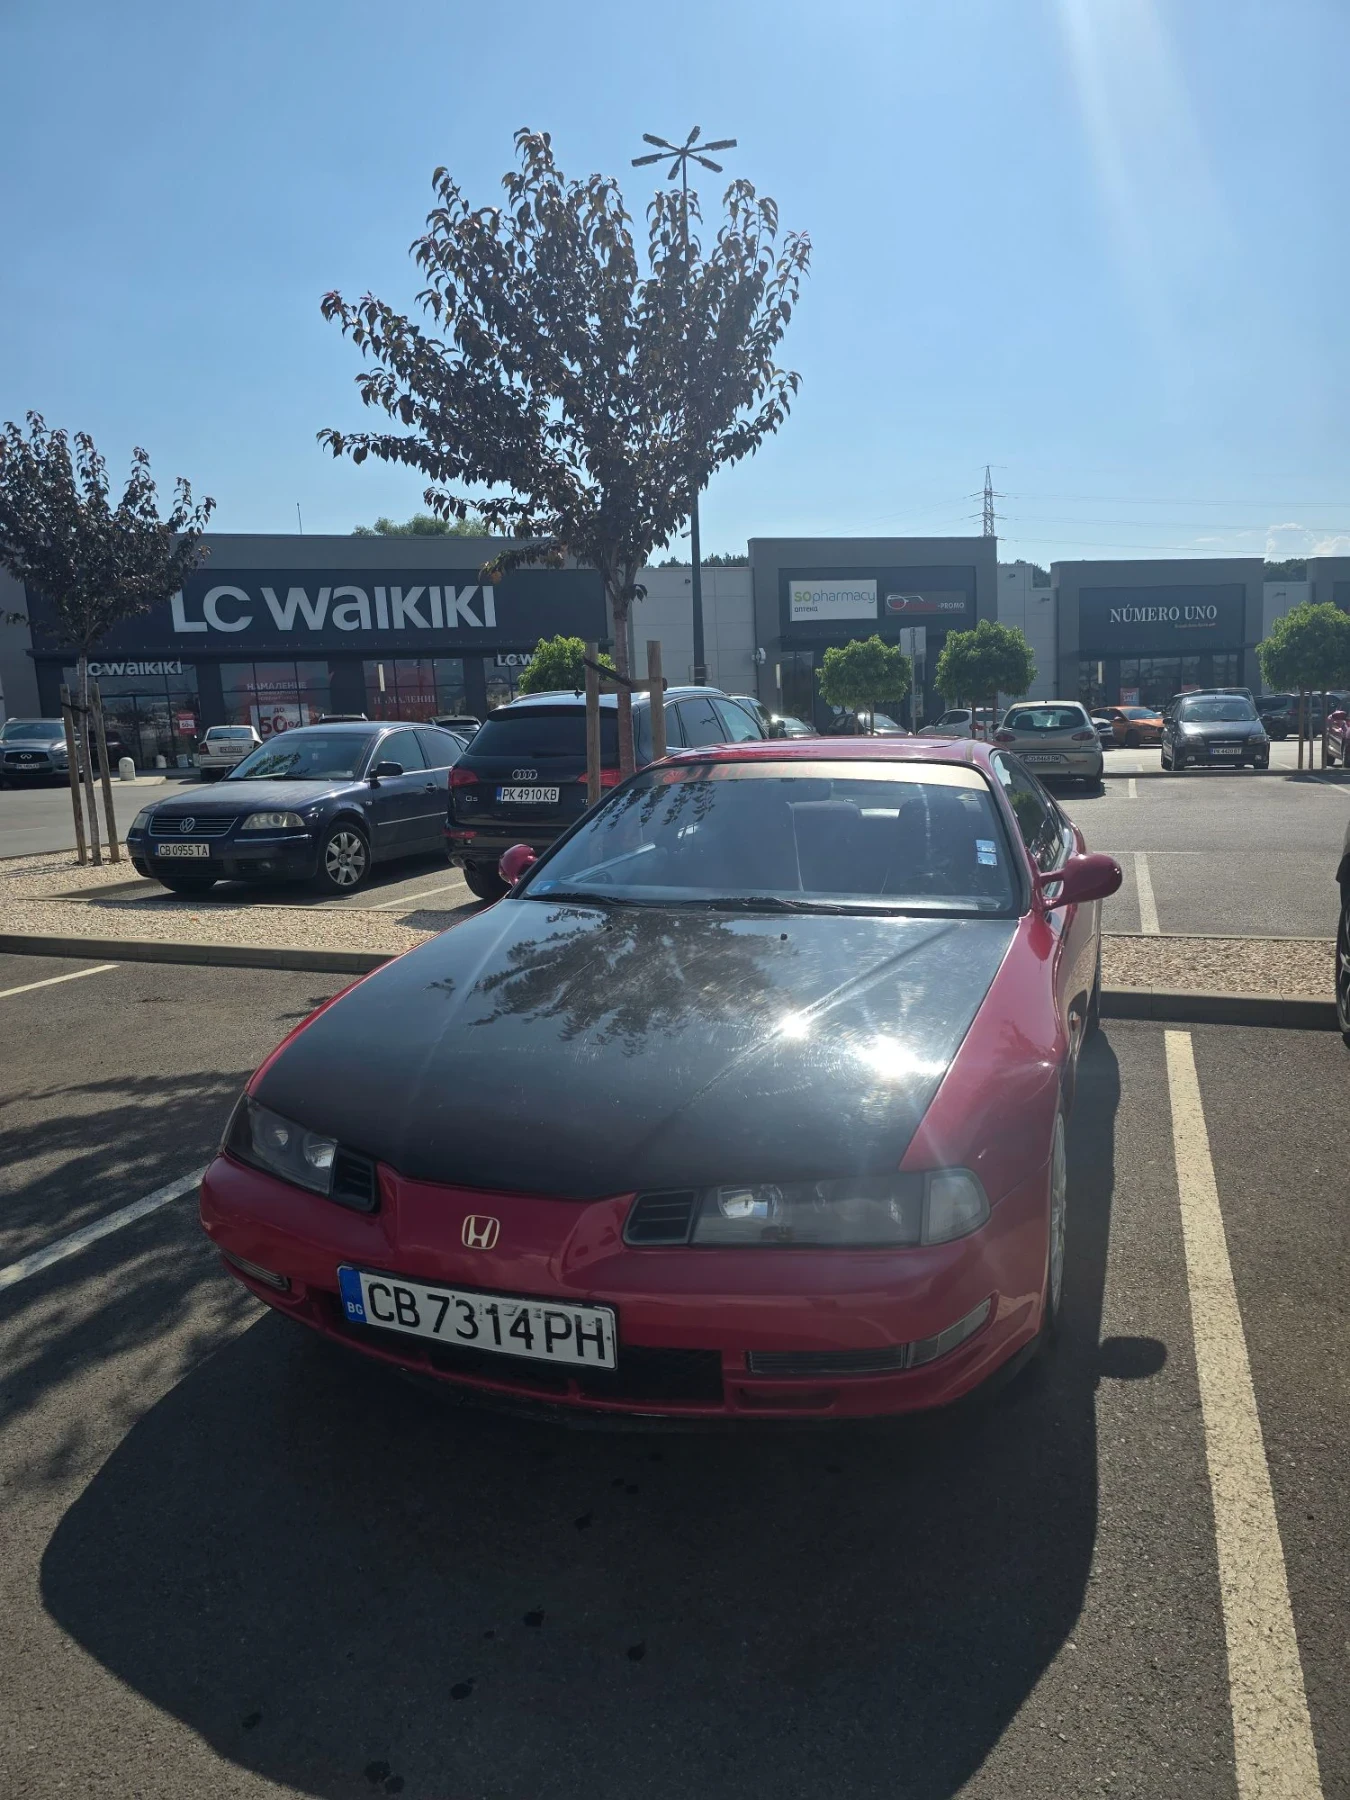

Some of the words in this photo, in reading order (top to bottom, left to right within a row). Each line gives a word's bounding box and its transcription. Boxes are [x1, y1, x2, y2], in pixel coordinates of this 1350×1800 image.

[794, 589, 875, 604] sopharmacy
[170, 585, 253, 633] LC
[1109, 603, 1180, 623] NÚMERO
[1184, 605, 1218, 620] UNO
[347, 1301, 364, 1316] BG
